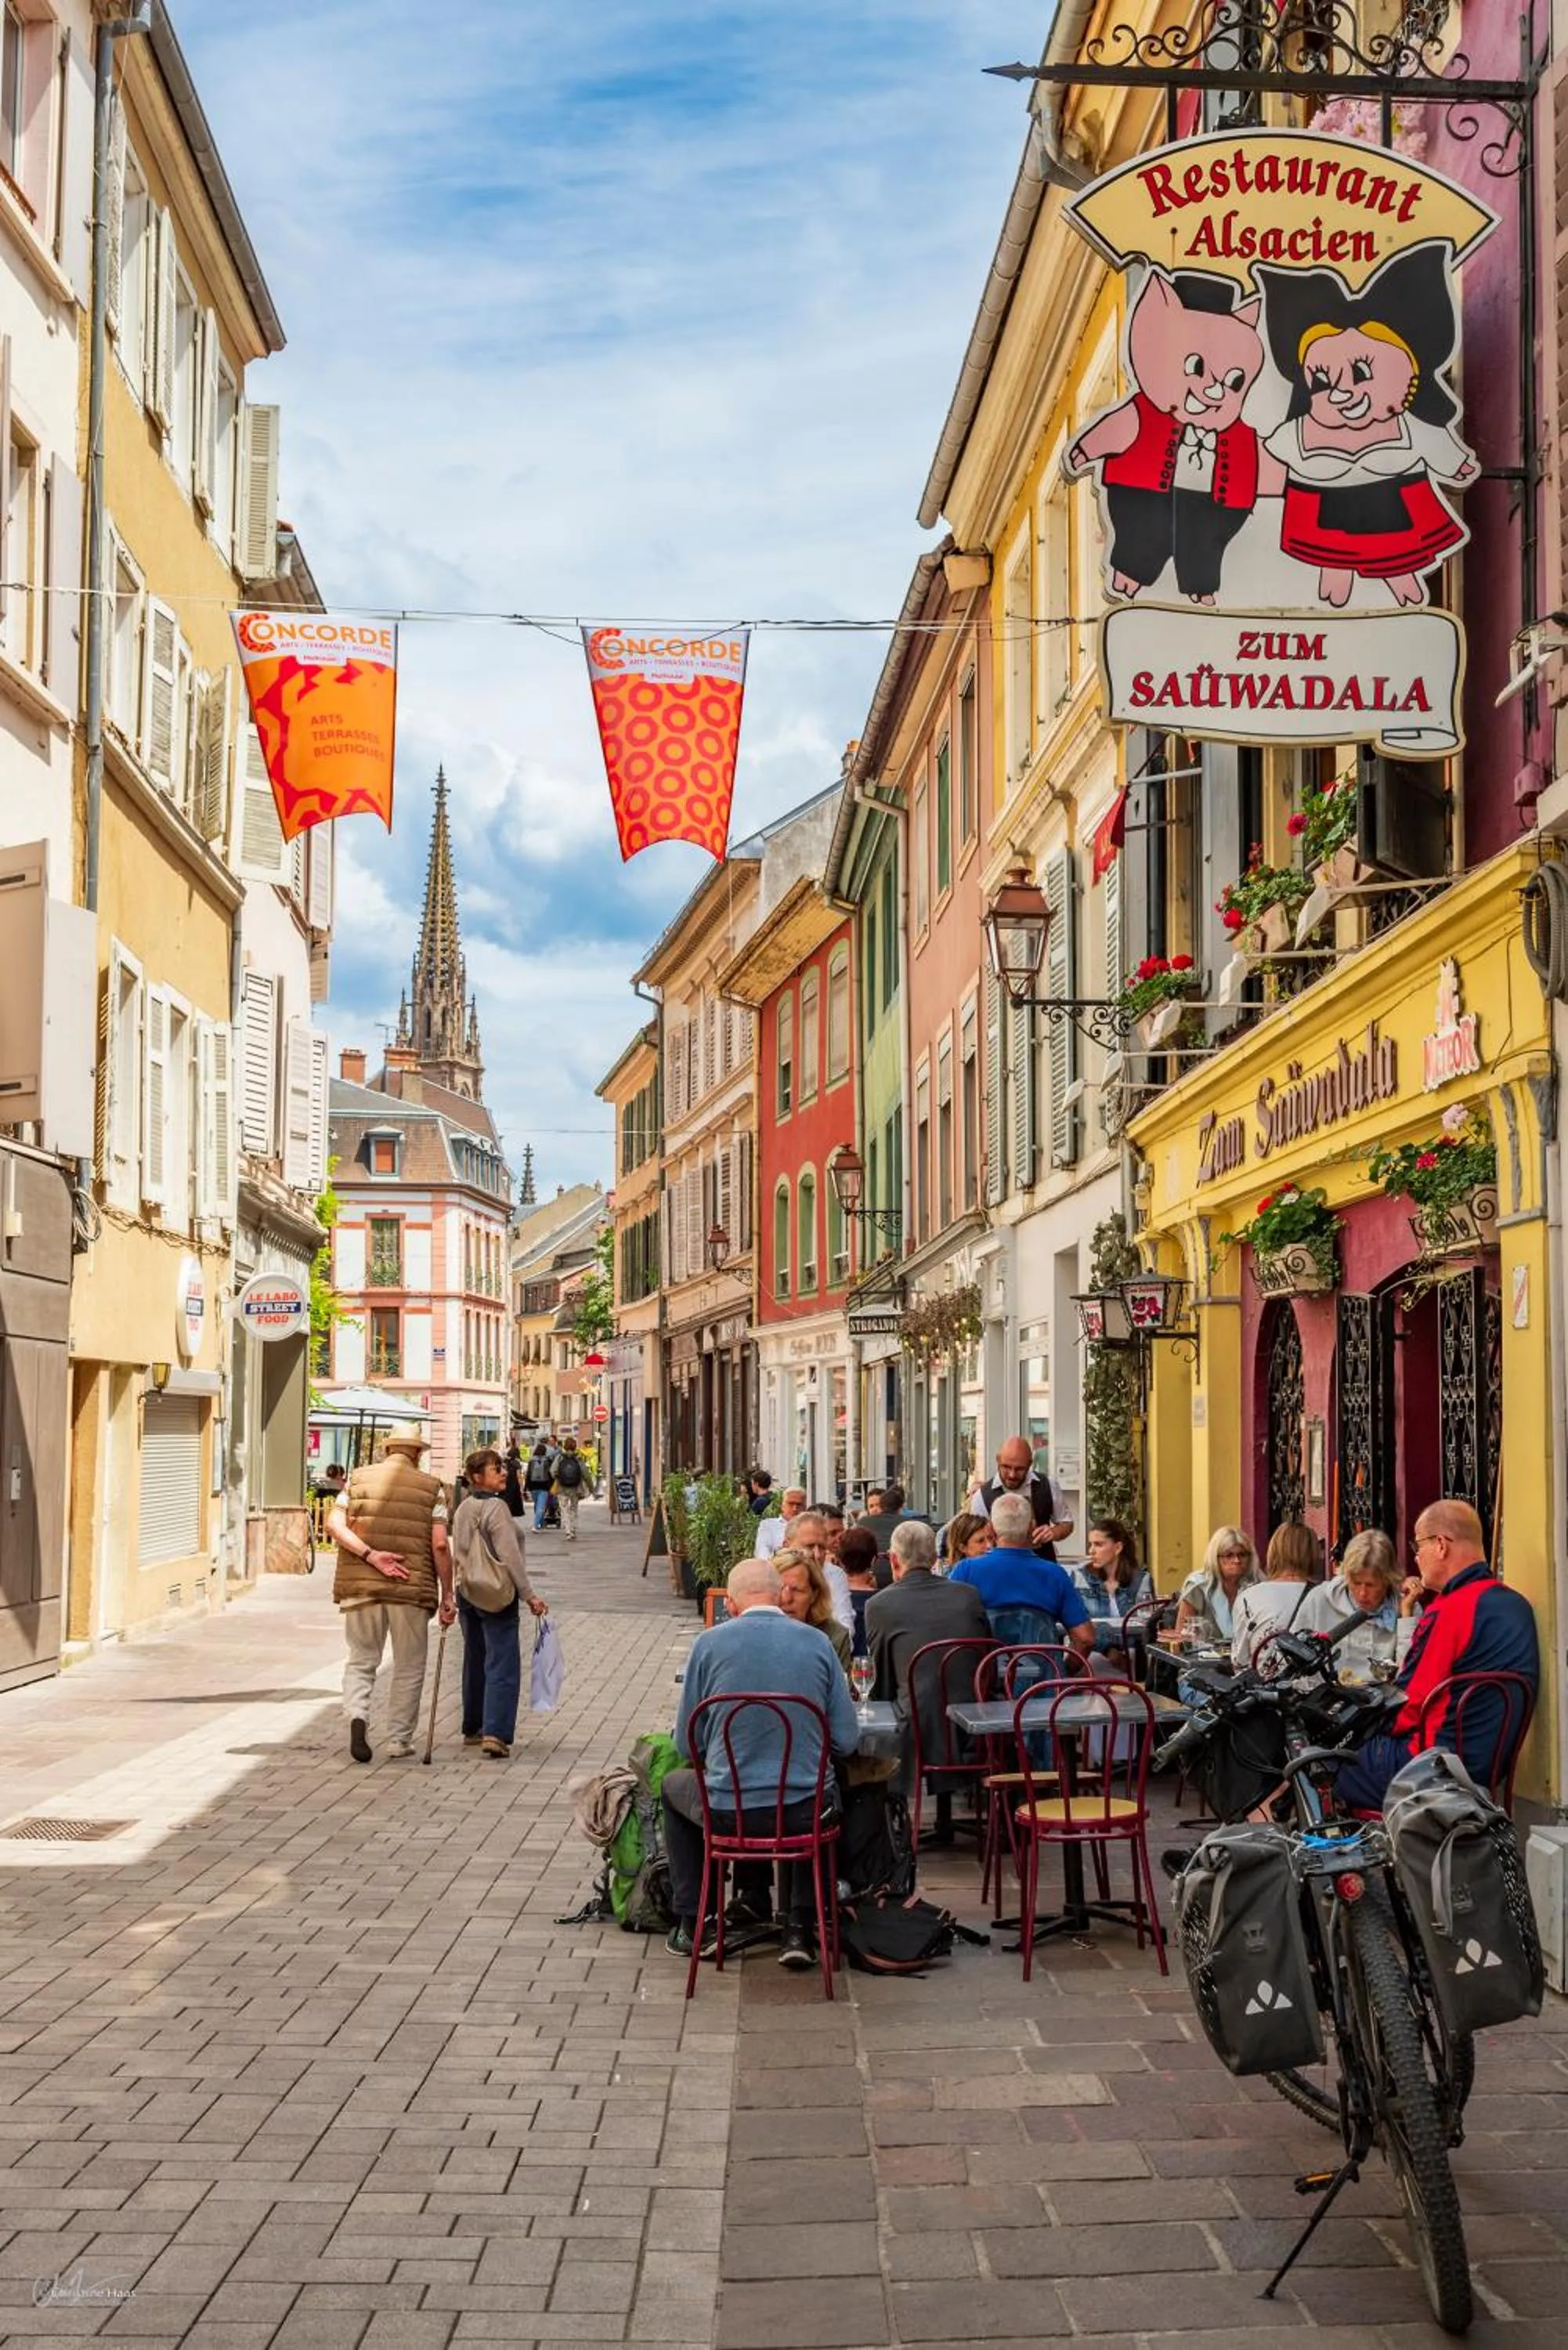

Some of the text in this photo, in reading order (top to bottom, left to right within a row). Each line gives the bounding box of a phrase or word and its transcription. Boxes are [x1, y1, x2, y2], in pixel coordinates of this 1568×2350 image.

[1137, 149, 1423, 223] Restaurant
[1184, 209, 1381, 262] Alsacien
[1237, 631, 1329, 662] ZUM
[1129, 663, 1433, 713] SAÜWADALA
[311, 714, 343, 726] ARTS
[312, 728, 381, 745] TERRASSES
[313, 743, 385, 762] BOUTIQUES
[1197, 1108, 1245, 1189] Zum
[250, 1291, 298, 1302] LE LABO
[249, 1303, 298, 1314] STREET
[257, 1314, 289, 1324] FOOD
